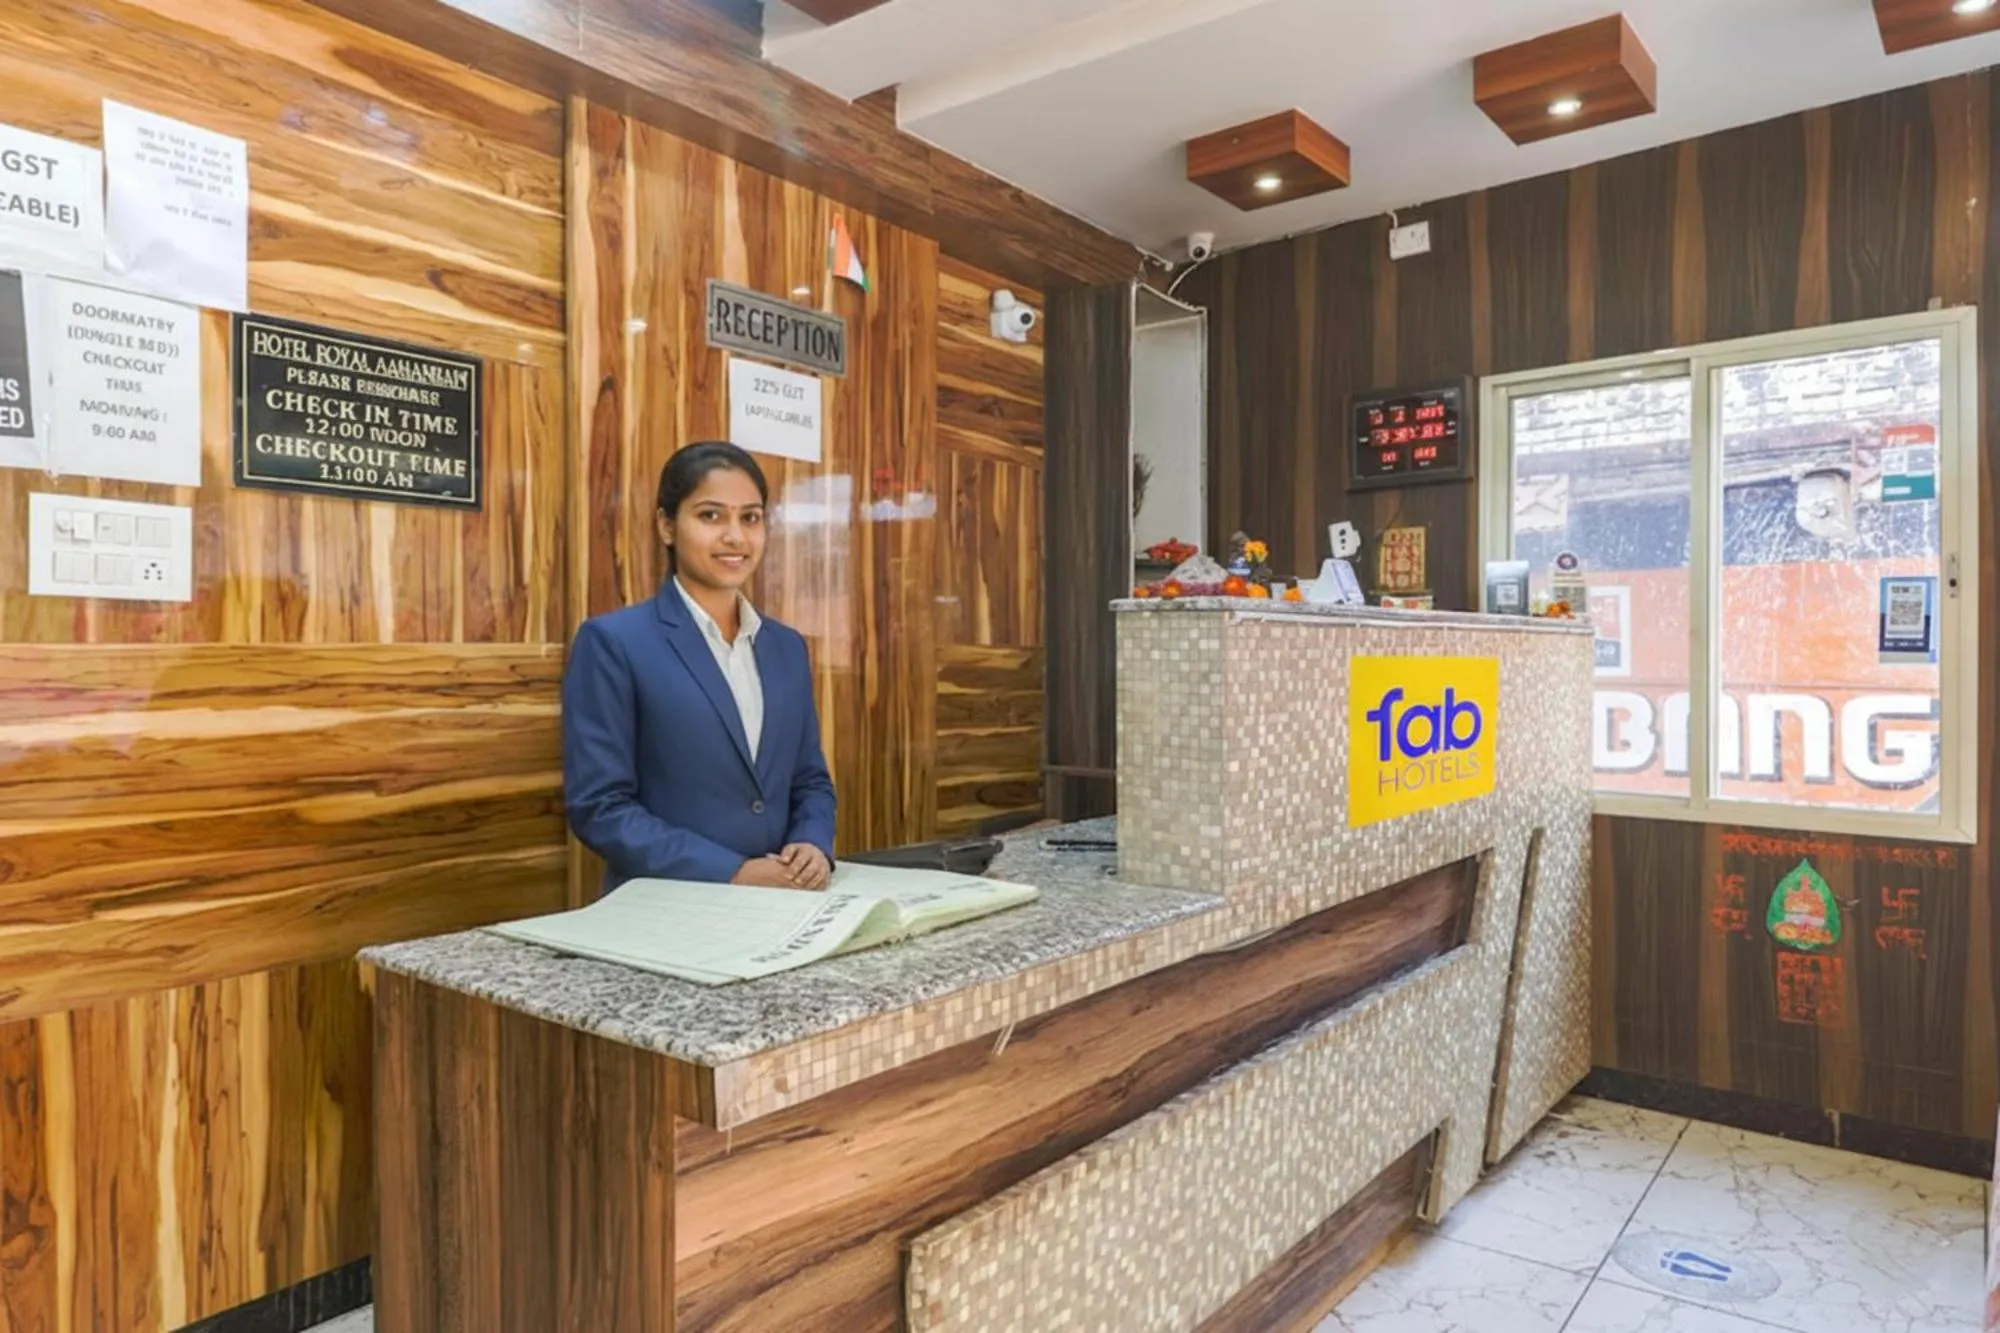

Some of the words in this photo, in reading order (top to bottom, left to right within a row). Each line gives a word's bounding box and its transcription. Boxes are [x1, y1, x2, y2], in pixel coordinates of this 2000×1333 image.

[1, 149, 59, 180] GST
[716, 297, 841, 363] RECEPTION
[265, 388, 357, 420] CHECK
[364, 403, 393, 427] IN
[399, 409, 458, 436] TIME
[305, 417, 365, 439] 12:00
[255, 433, 401, 468] CHECKOUT
[1366, 687, 1482, 762] fab
[1378, 752, 1480, 797] HOTELS
